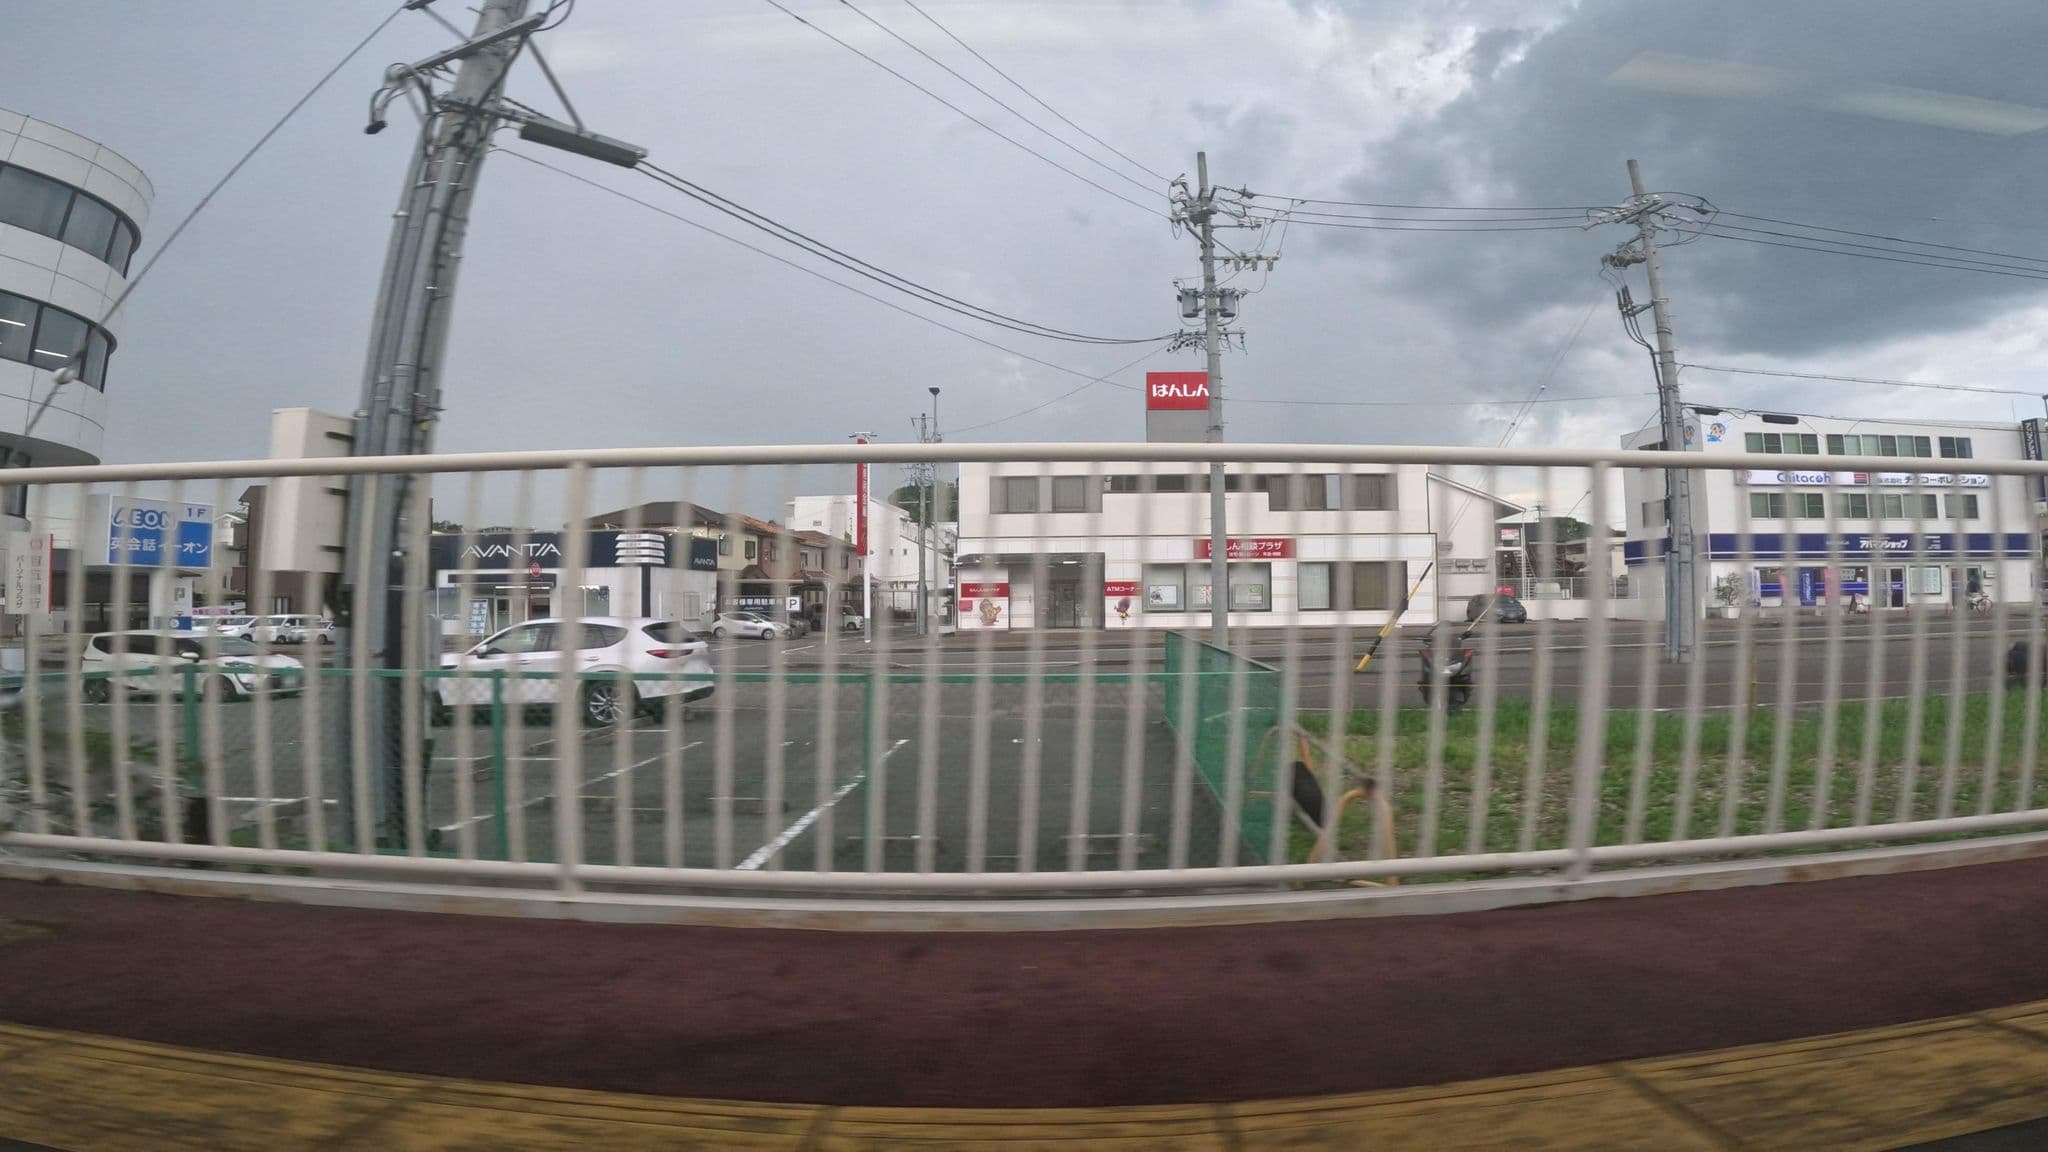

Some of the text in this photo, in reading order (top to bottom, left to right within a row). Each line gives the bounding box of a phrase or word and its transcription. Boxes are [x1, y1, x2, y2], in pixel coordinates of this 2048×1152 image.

[1151, 383, 1210, 398] はんしん
[1904, 475, 1986, 485] チコーポレーション
[186, 507, 207, 519] 1F
[111, 537, 209, 555] 英会話イーオン
[460, 542, 562, 558] AVANTIA
[789, 598, 798, 609] P
